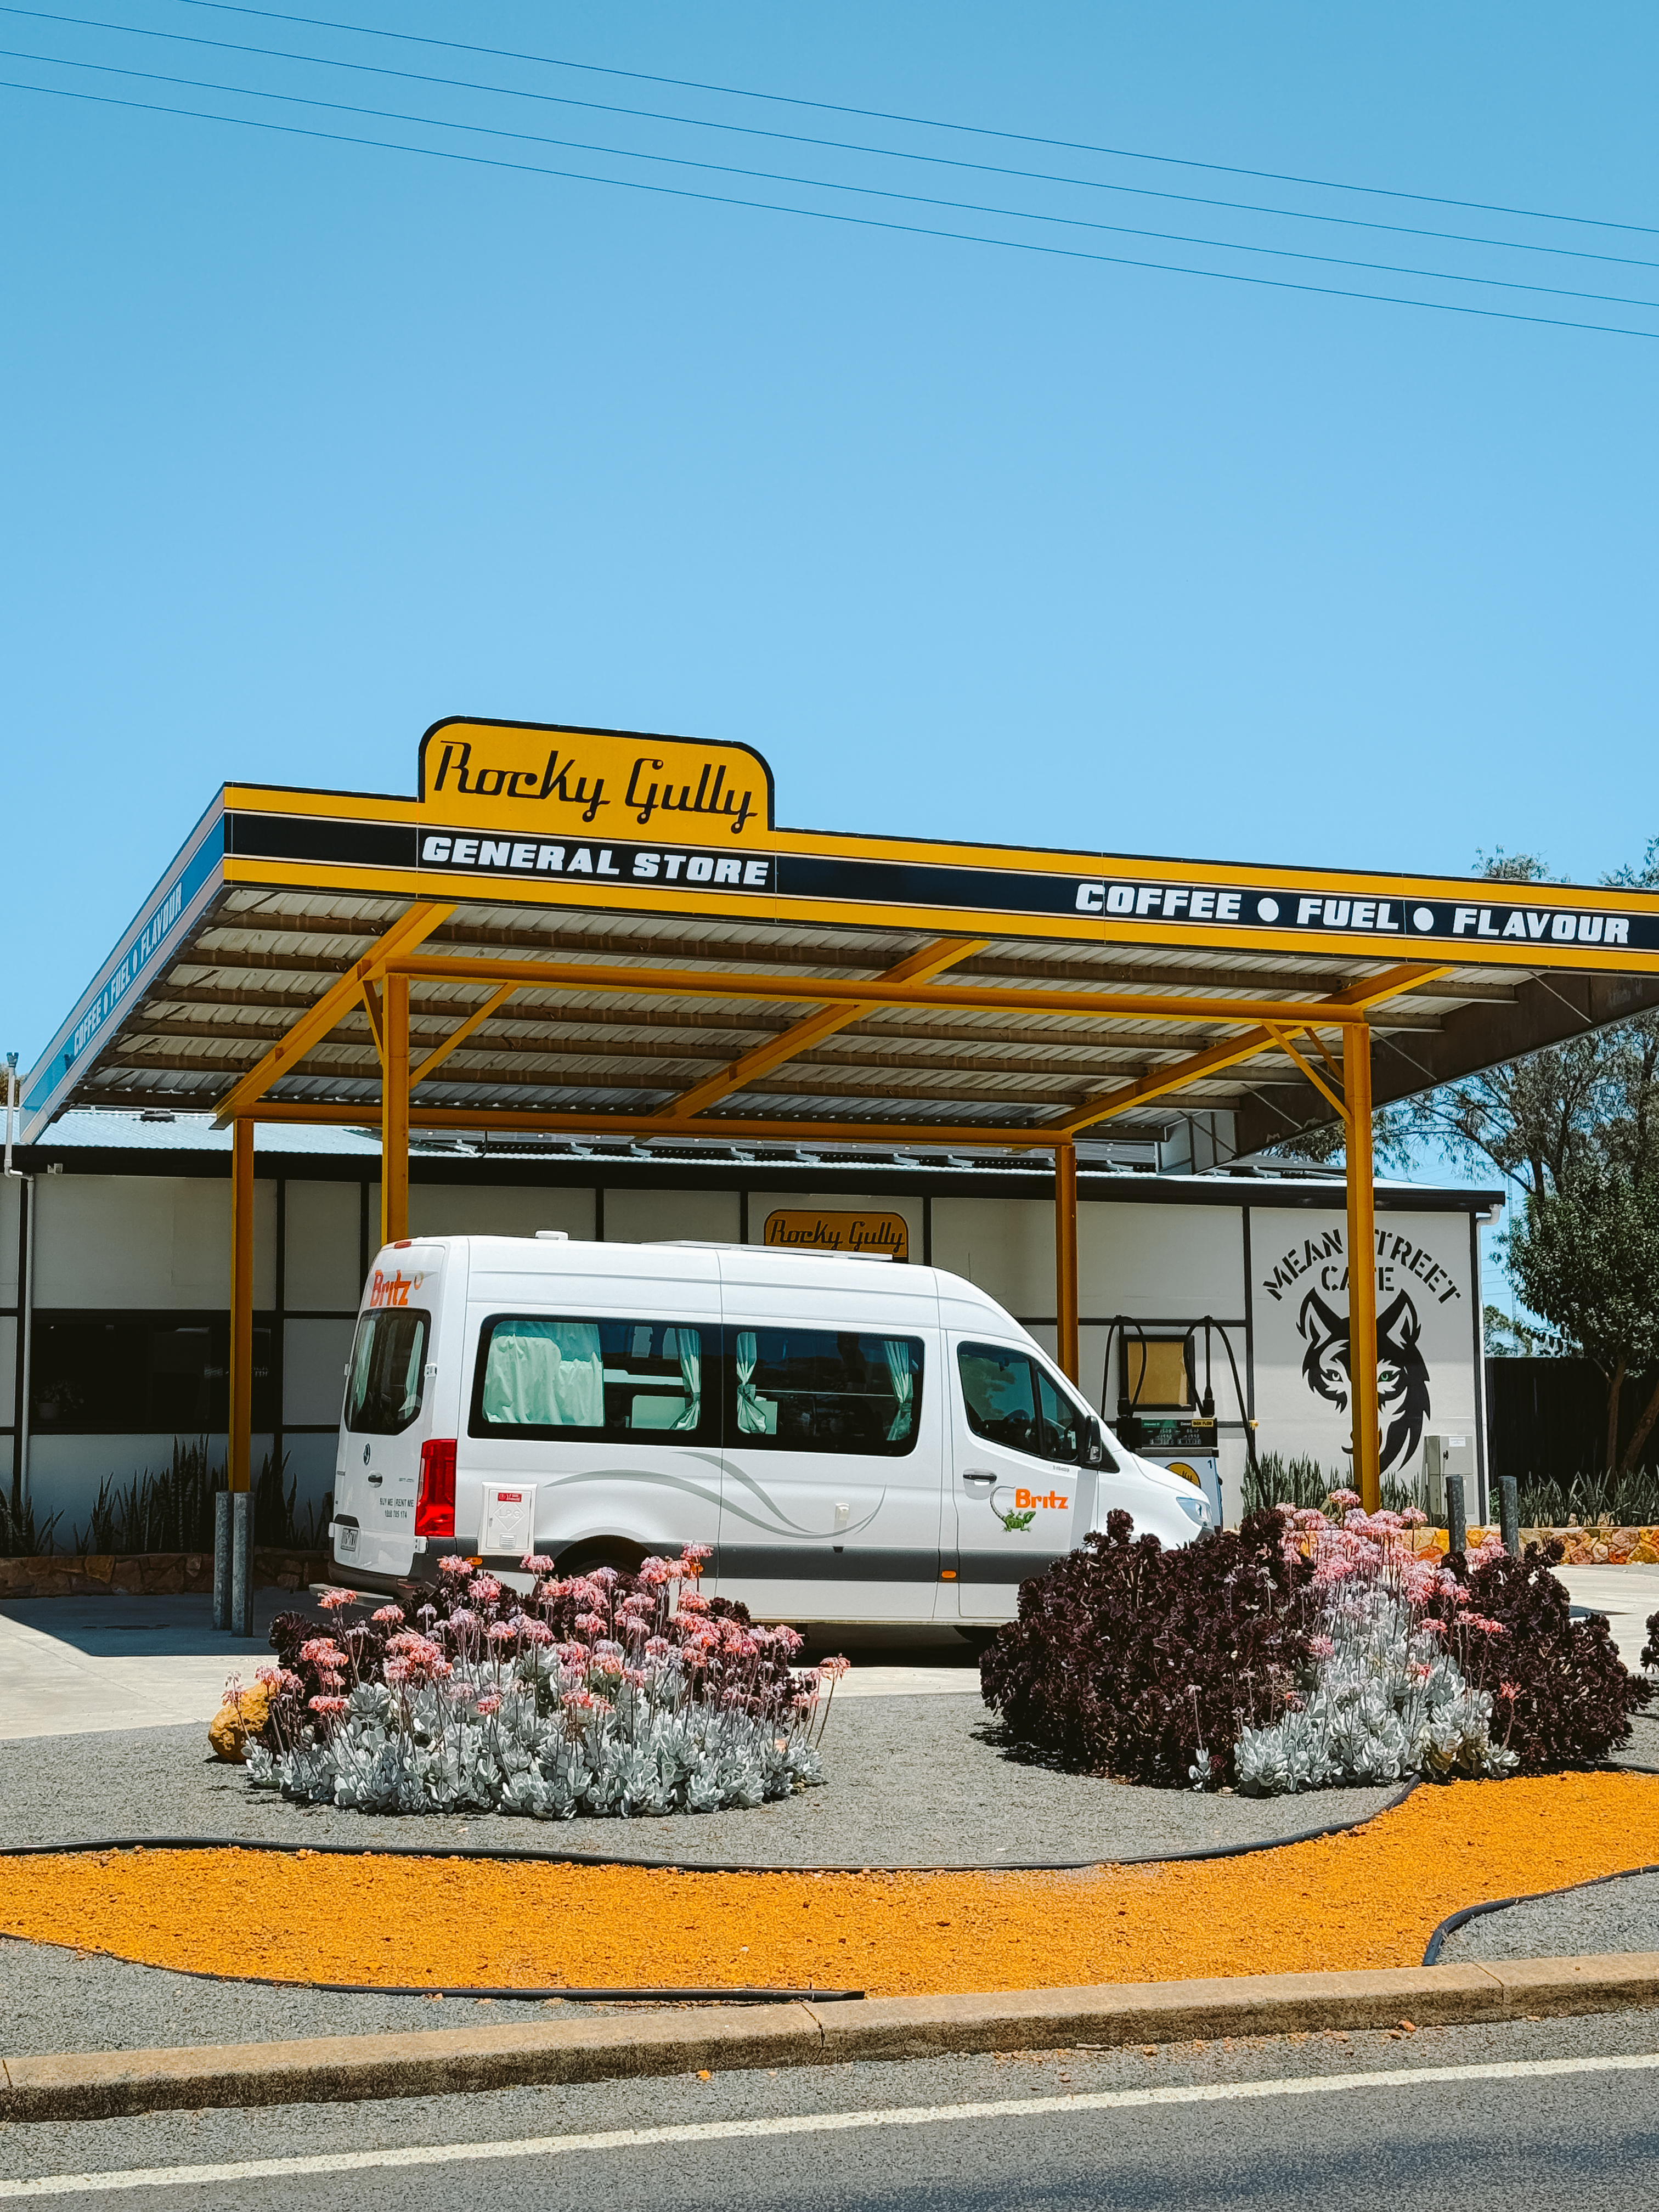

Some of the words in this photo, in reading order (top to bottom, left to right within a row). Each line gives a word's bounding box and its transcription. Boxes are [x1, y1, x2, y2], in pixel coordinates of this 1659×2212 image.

[434, 741, 610, 822] Rocky
[625, 758, 758, 834] Gully
[422, 837, 620, 875] GENERAL
[633, 853, 769, 885] STORE
[1075, 883, 1242, 921] COFFEE
[1296, 897, 1400, 930] FUEL
[1453, 907, 1630, 945] FLAVOUR
[74, 997, 102, 1057] COFFEE
[110, 957, 131, 1008] FUEL
[140, 882, 183, 964] FLAVOUR
[770, 1219, 843, 1250] Rocky
[849, 1221, 905, 1253] Gully
[370, 1269, 412, 1308] Britz
[1262, 1228, 1344, 1301] MEAN
[1374, 1228, 1462, 1304] TREET
[1321, 1266, 1395, 1291] CAE
[1015, 1488, 1069, 1509] Britz
